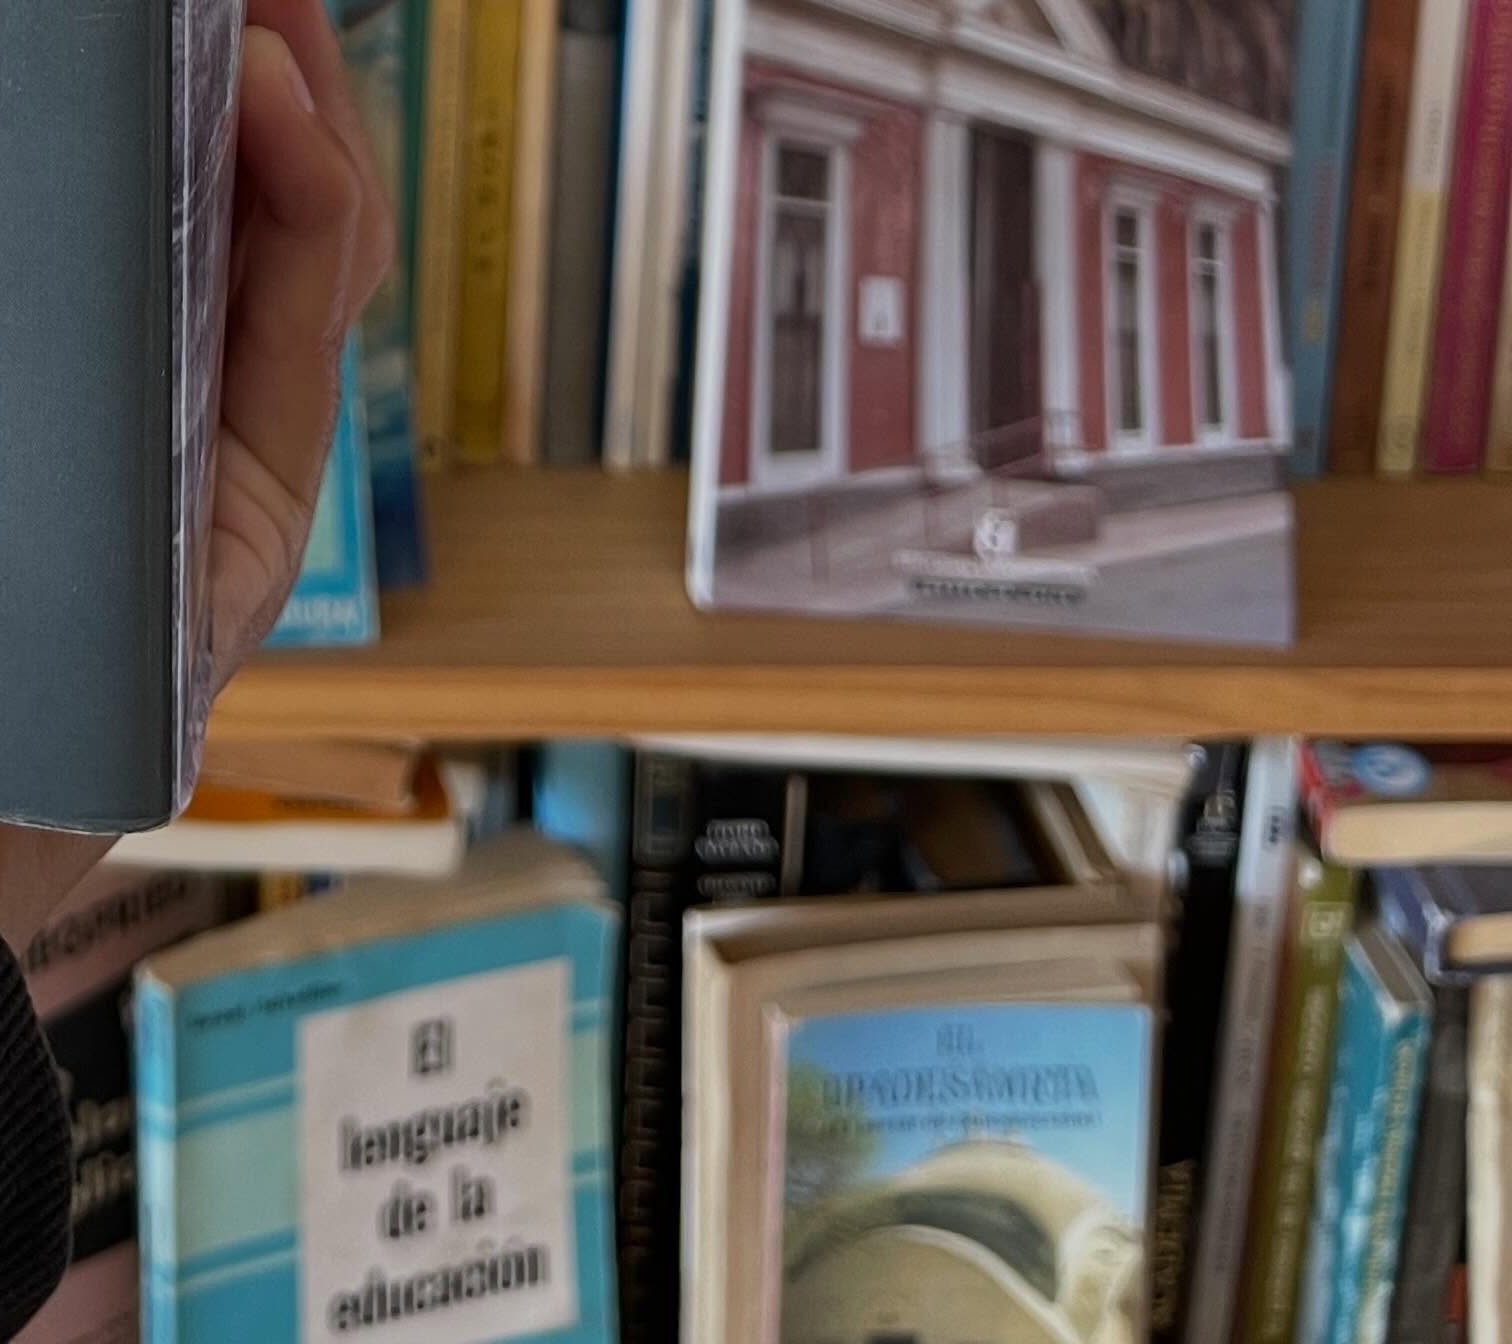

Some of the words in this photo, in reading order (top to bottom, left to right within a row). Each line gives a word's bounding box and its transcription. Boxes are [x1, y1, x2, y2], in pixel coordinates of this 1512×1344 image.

[340, 1080, 530, 1172] lenguaje
[378, 1180, 434, 1240] de
[450, 1165, 493, 1226] la
[328, 1238, 550, 1332] educación
